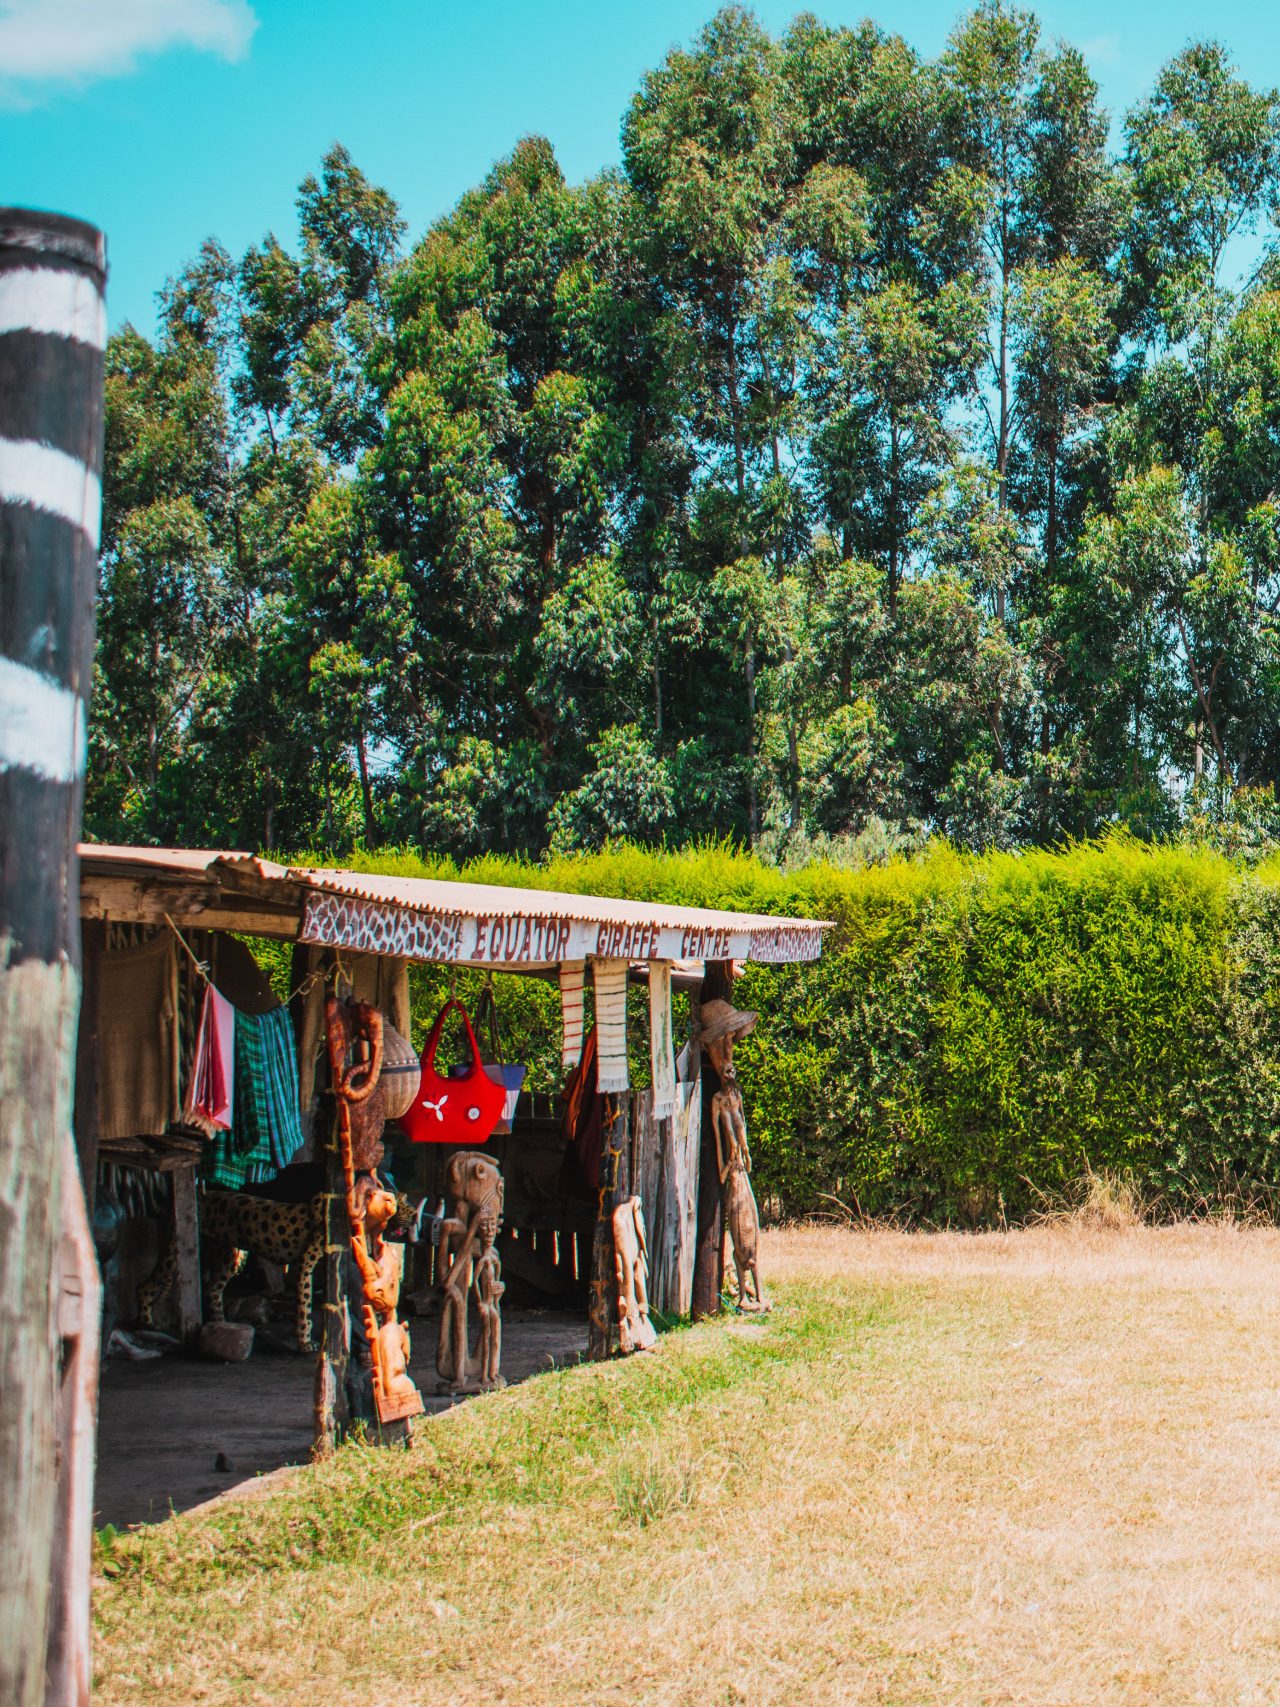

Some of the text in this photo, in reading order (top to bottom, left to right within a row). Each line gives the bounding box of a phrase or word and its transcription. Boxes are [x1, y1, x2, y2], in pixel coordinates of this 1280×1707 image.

[471, 918, 730, 961] EQUATOR GIRAFFE CENTRE
